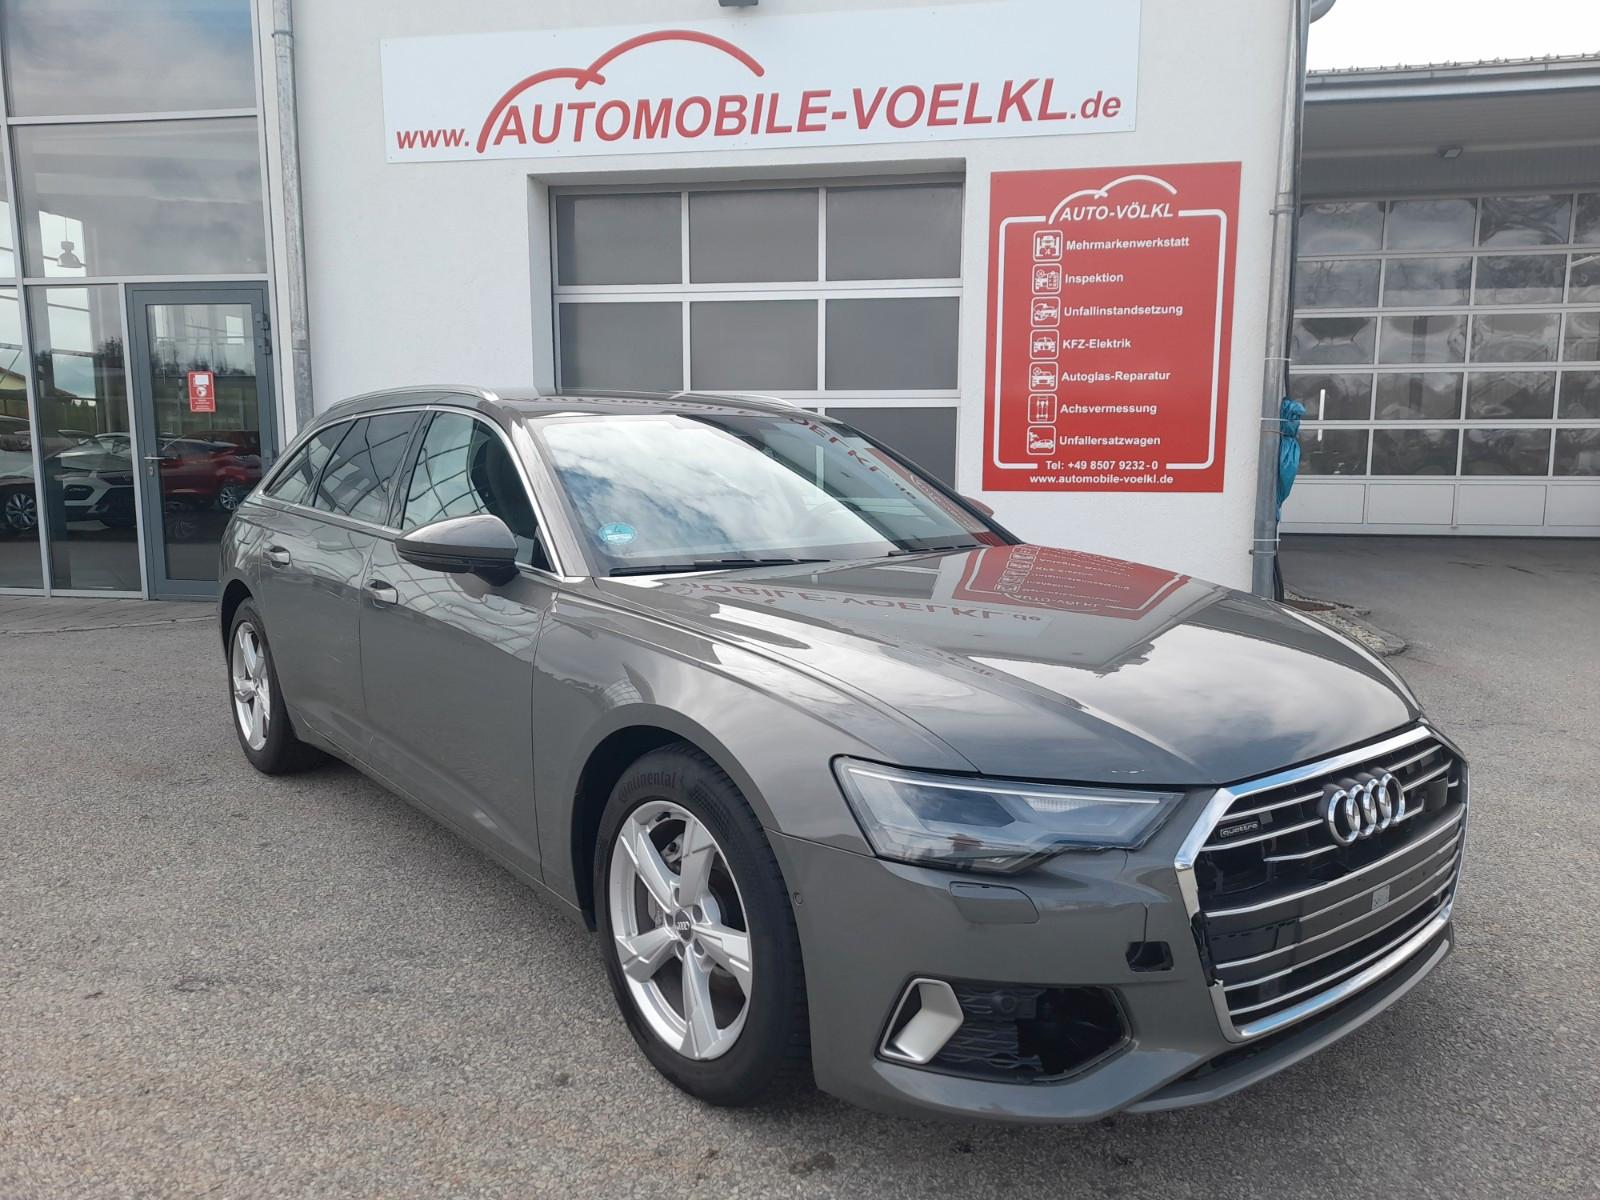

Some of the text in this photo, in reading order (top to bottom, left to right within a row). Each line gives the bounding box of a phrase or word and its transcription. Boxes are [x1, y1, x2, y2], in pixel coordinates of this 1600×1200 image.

[1059, 202, 1174, 221] AUTO-VÖLKL
[1066, 237, 1190, 251] Mehrmarkenwerkstatt
[1065, 273, 1124, 285] Inspektion
[1064, 305, 1184, 317] Unfallinstandsetzung
[1062, 338, 1132, 349] KFZ-Elektrik
[1061, 371, 1171, 383] Autoglas-Reparatur
[1060, 404, 1158, 415] Achsvermessung
[1059, 436, 1161, 447] Unfallersatzwagen
[1045, 460, 1065, 470] Tel:
[1067, 460, 1087, 470] +49
[1090, 460, 1116, 470] 8507
[1029, 474, 1174, 484] www.automobile-voelkl.de
[618, 770, 678, 803] Continental
[1222, 822, 1258, 836] quattro
